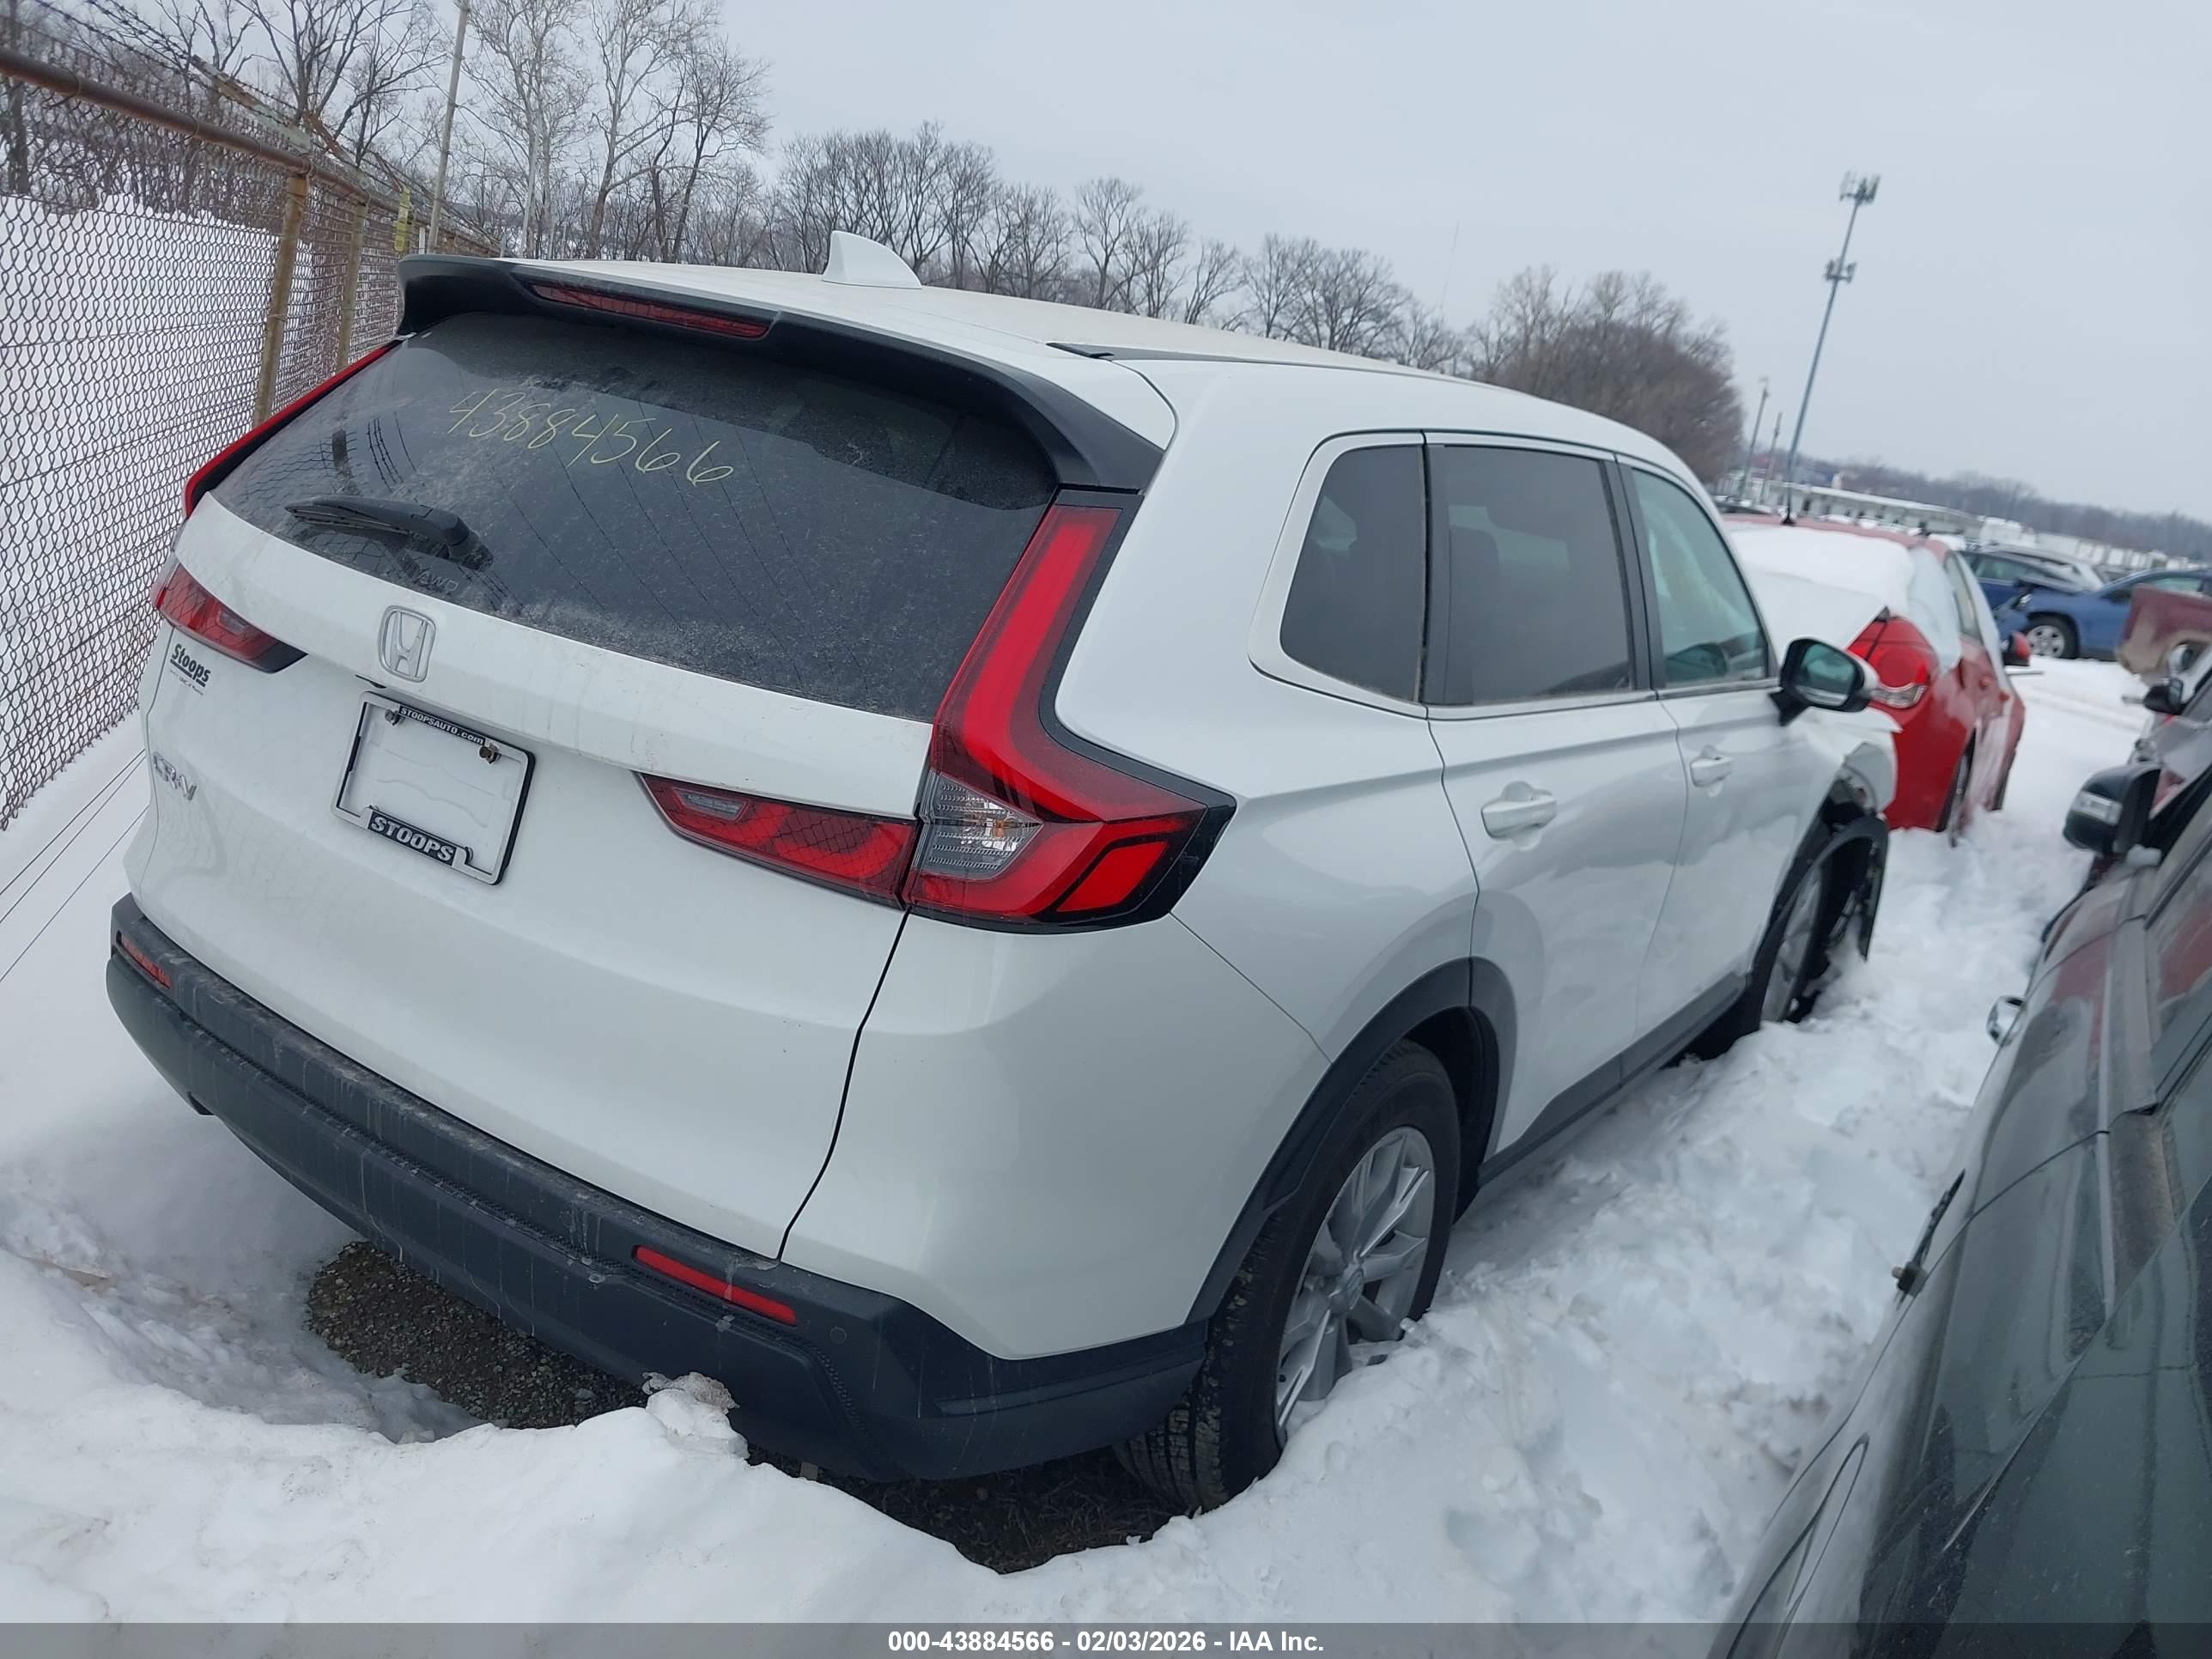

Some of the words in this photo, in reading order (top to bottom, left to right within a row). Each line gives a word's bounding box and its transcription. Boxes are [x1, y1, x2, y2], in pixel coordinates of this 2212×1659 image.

[447, 388, 734, 486] 43884566
[171, 642, 211, 684] Stoops
[400, 706, 484, 745] STOOPSAUTO.com
[371, 816, 454, 861] STOOPS
